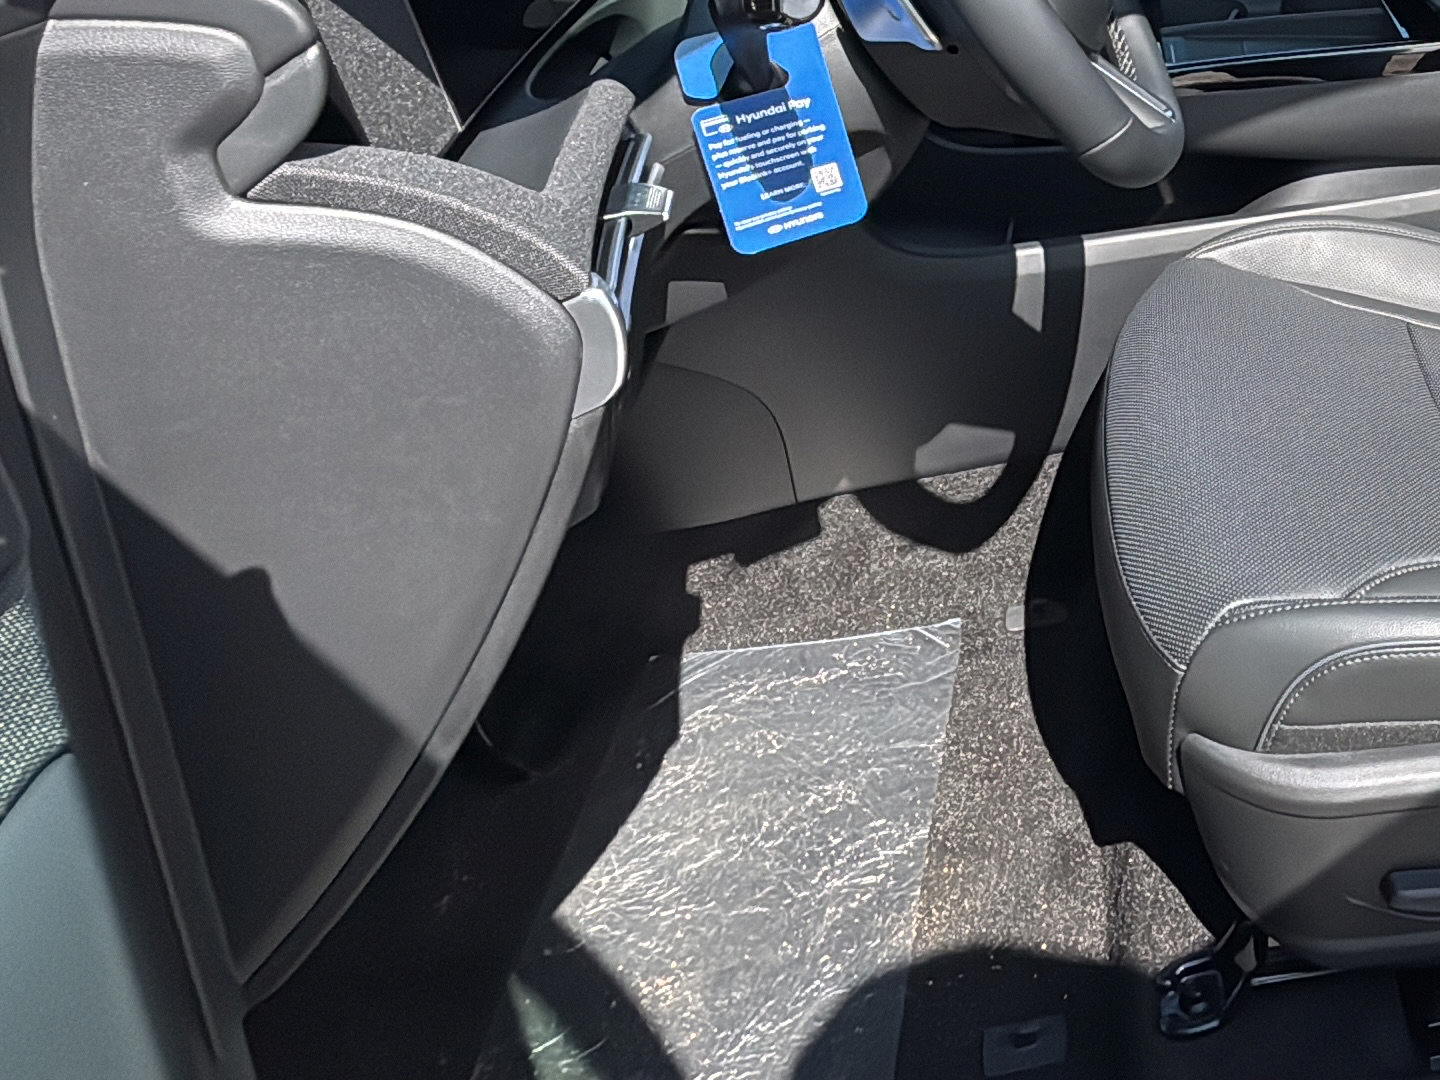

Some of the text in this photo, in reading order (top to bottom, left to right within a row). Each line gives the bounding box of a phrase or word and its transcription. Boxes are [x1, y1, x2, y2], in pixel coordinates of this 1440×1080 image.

[735, 97, 810, 124] Hyundai Pay
[734, 131, 761, 142] fueling
[770, 119, 803, 132] charging
[756, 138, 771, 147] and
[771, 135, 785, 143] pay
[750, 150, 765, 159] and
[765, 142, 795, 155] securely
[806, 134, 823, 145] your
[754, 151, 799, 168] touchscreen
